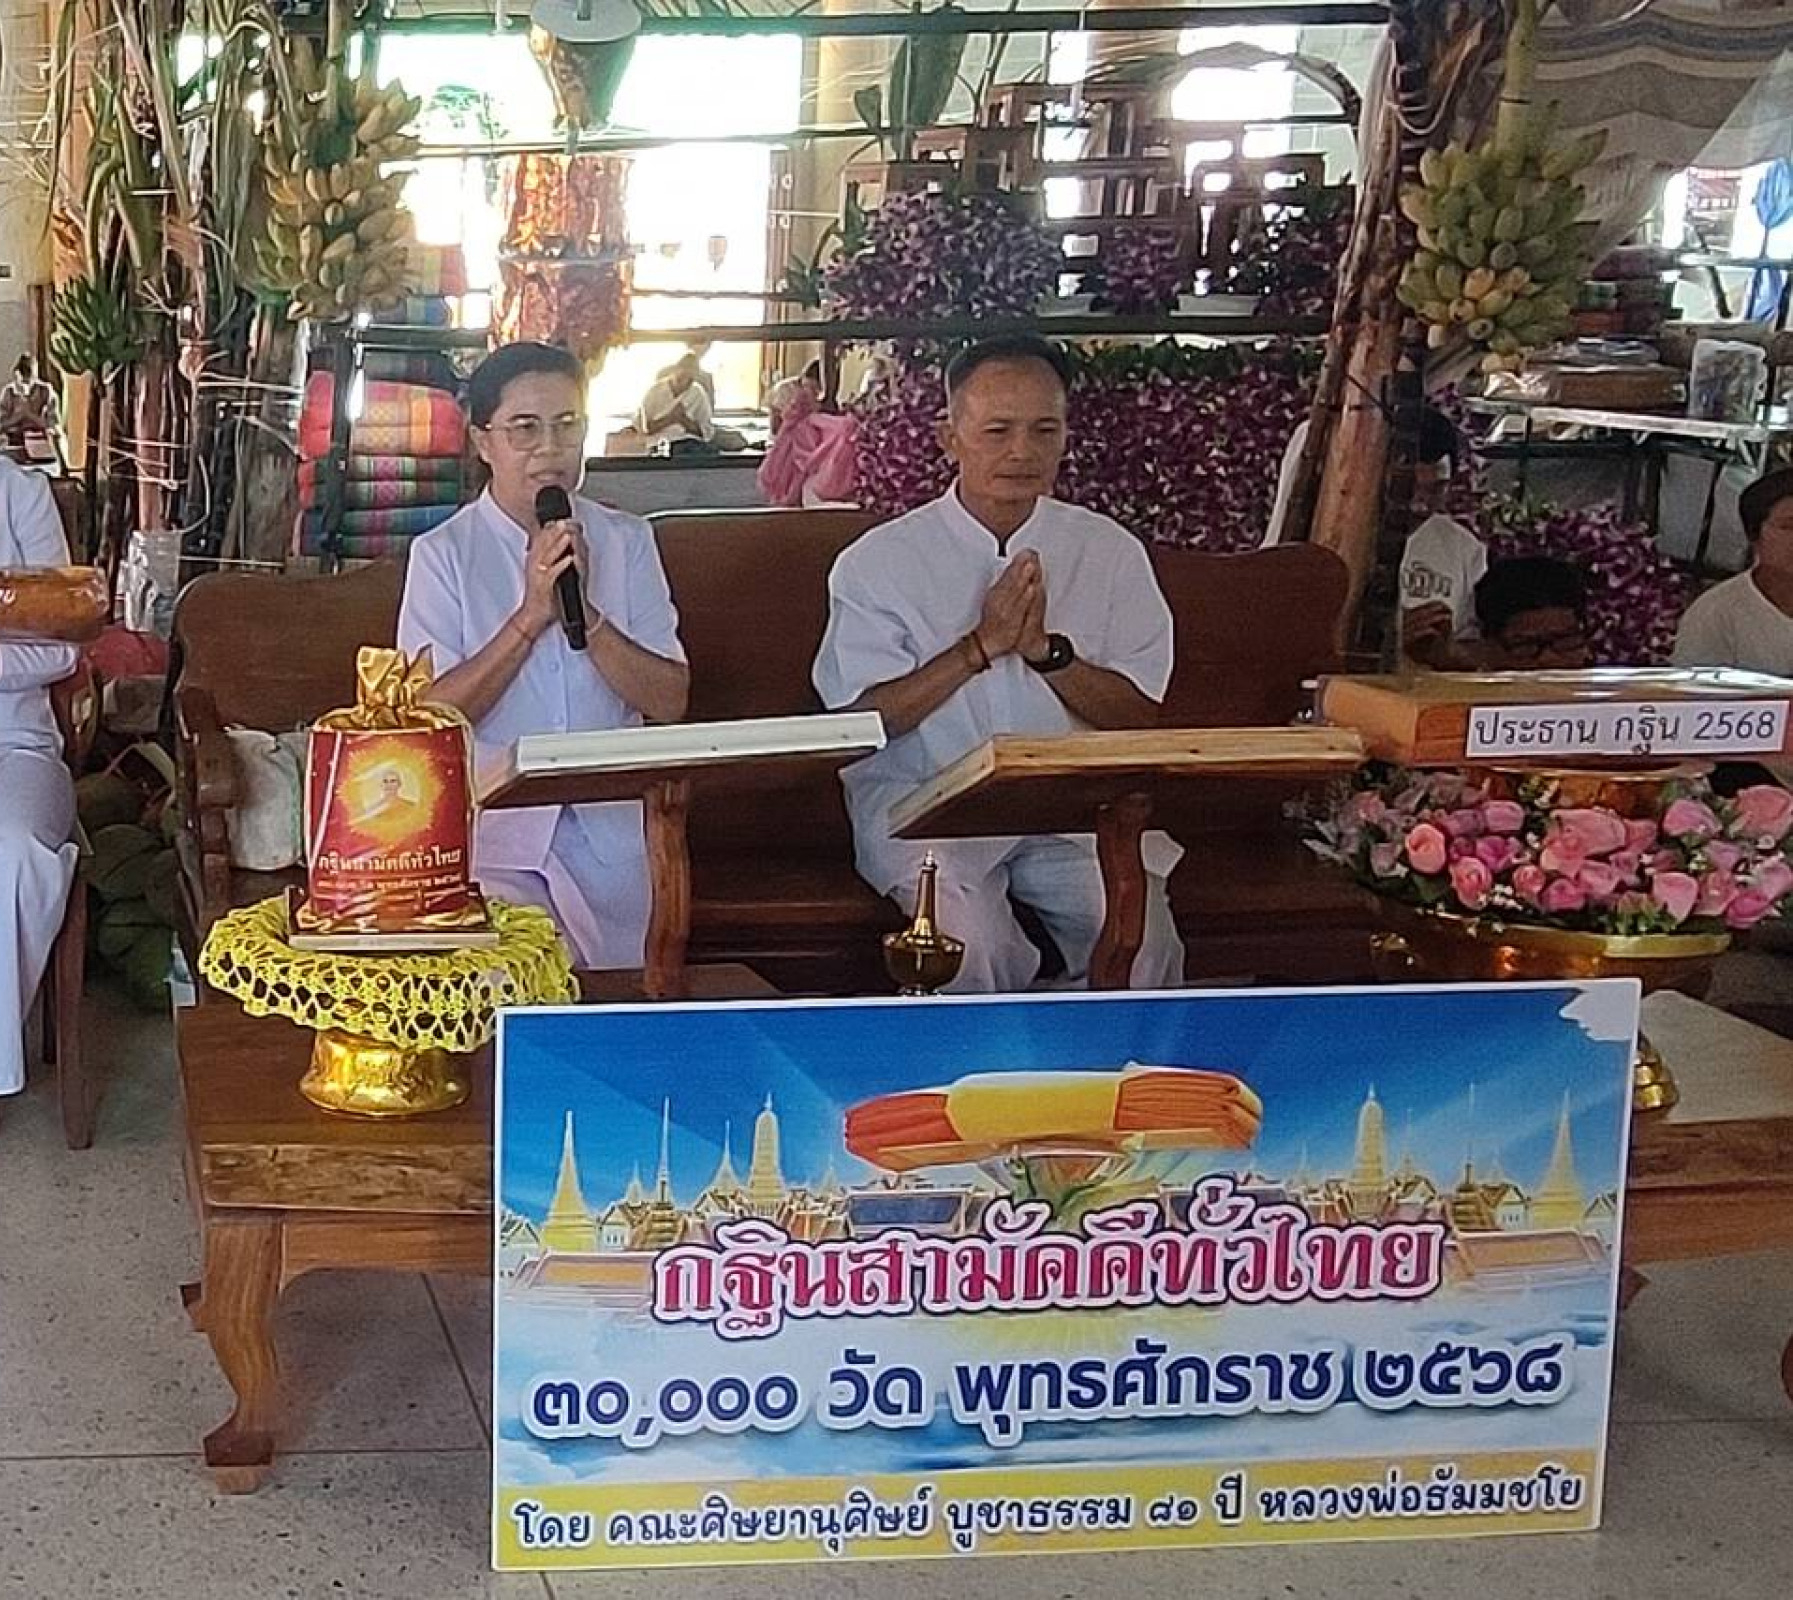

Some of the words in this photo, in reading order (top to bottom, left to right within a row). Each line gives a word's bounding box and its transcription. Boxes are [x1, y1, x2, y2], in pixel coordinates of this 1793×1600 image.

[1474, 711, 1598, 745] ประธาน
[1614, 704, 1681, 756] กฐิน
[1692, 711, 1776, 740] 2568
[658, 1180, 1440, 1334] กฐินสามัคคีทั่วไทย
[531, 1374, 800, 1437] ๓๐,๐๐๐
[828, 1347, 925, 1418] วัด
[954, 1336, 1337, 1436] พุทธศักราช
[1364, 1340, 1565, 1399] ๒๕๖๘
[512, 1504, 591, 1545] โดย
[608, 1486, 933, 1552] คณะศิษยานุศิษย์
[947, 1497, 1132, 1549] บูชาธรรม
[1149, 1496, 1198, 1523] ๘๑
[1214, 1473, 1243, 1520] ปี
[1259, 1465, 1582, 1519] หลวงพ่อธัมมชโย
